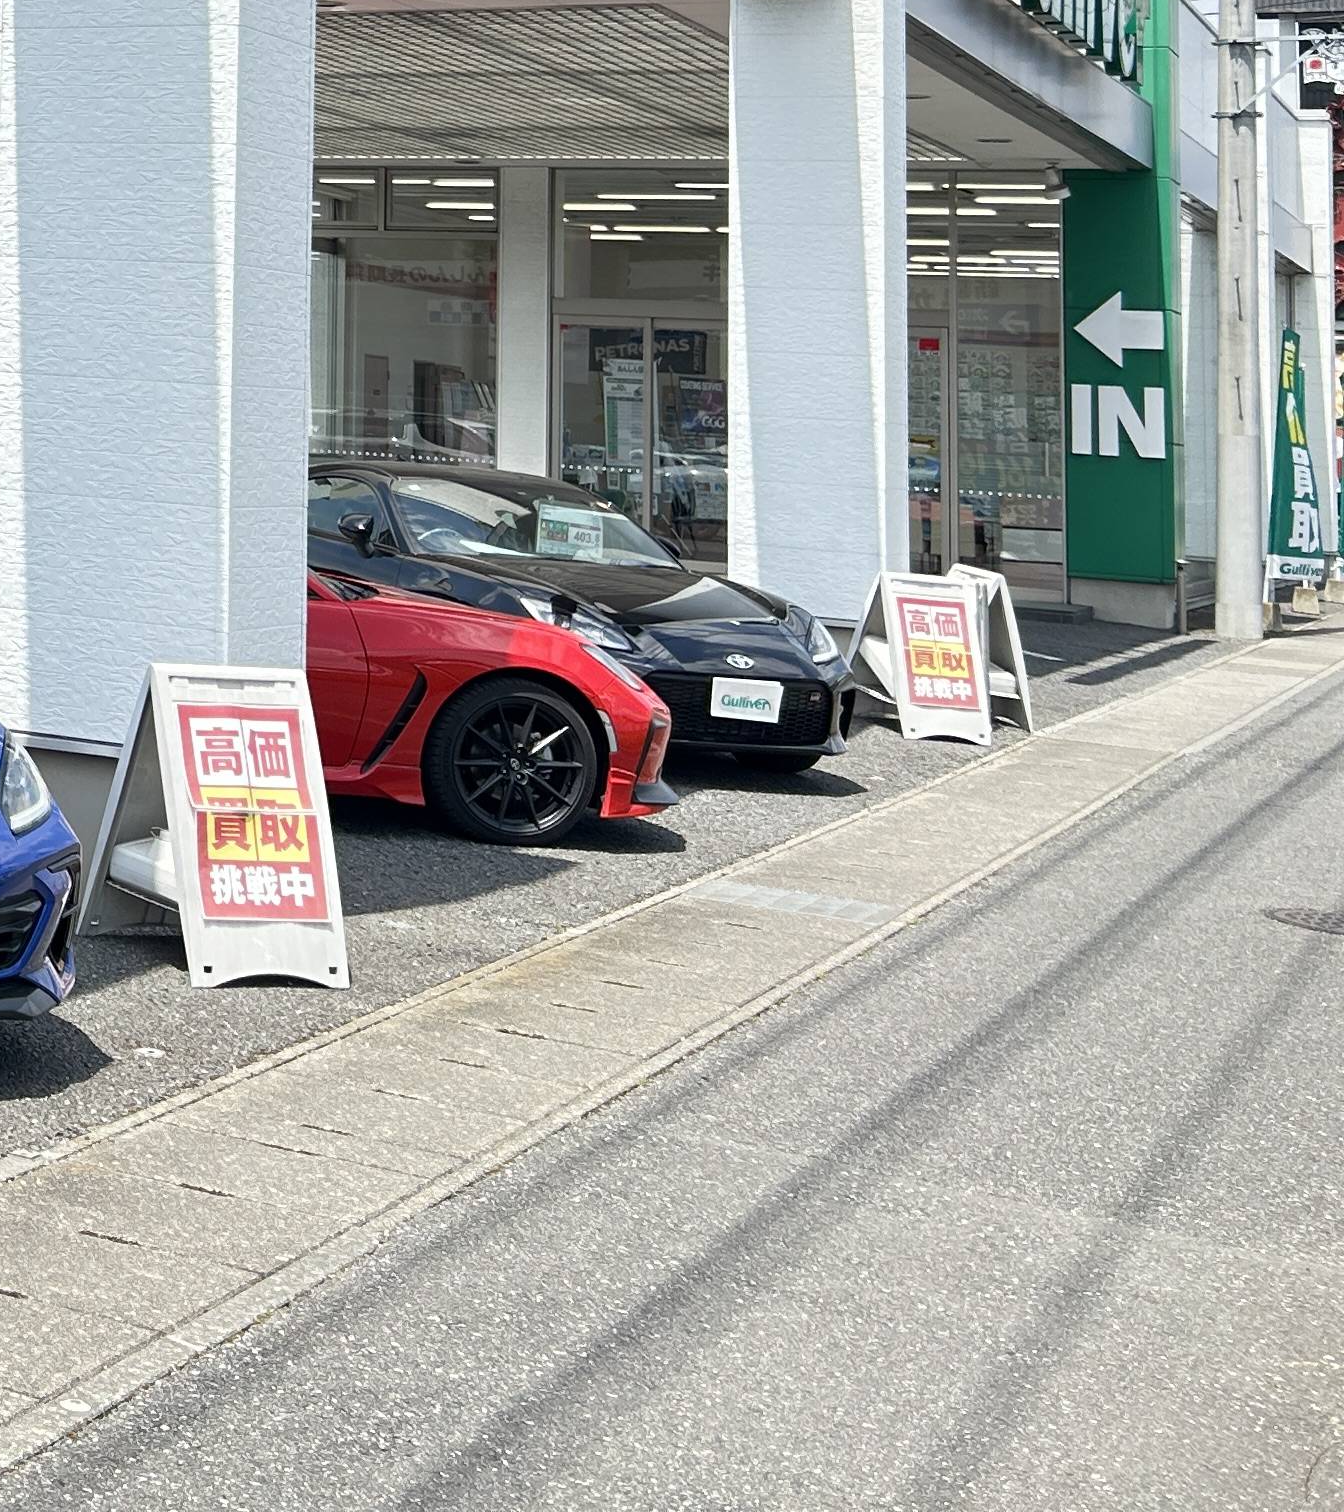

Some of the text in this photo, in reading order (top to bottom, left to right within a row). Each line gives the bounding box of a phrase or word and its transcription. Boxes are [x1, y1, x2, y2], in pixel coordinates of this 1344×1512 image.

[1071, 383, 1167, 460] IN
[906, 609, 961, 638] 高価
[721, 693, 772, 711] Gulliver
[913, 676, 973, 701] 挑戦中
[195, 726, 292, 779] 高価
[206, 796, 305, 853] 買取
[209, 864, 316, 908] 挑戦中
